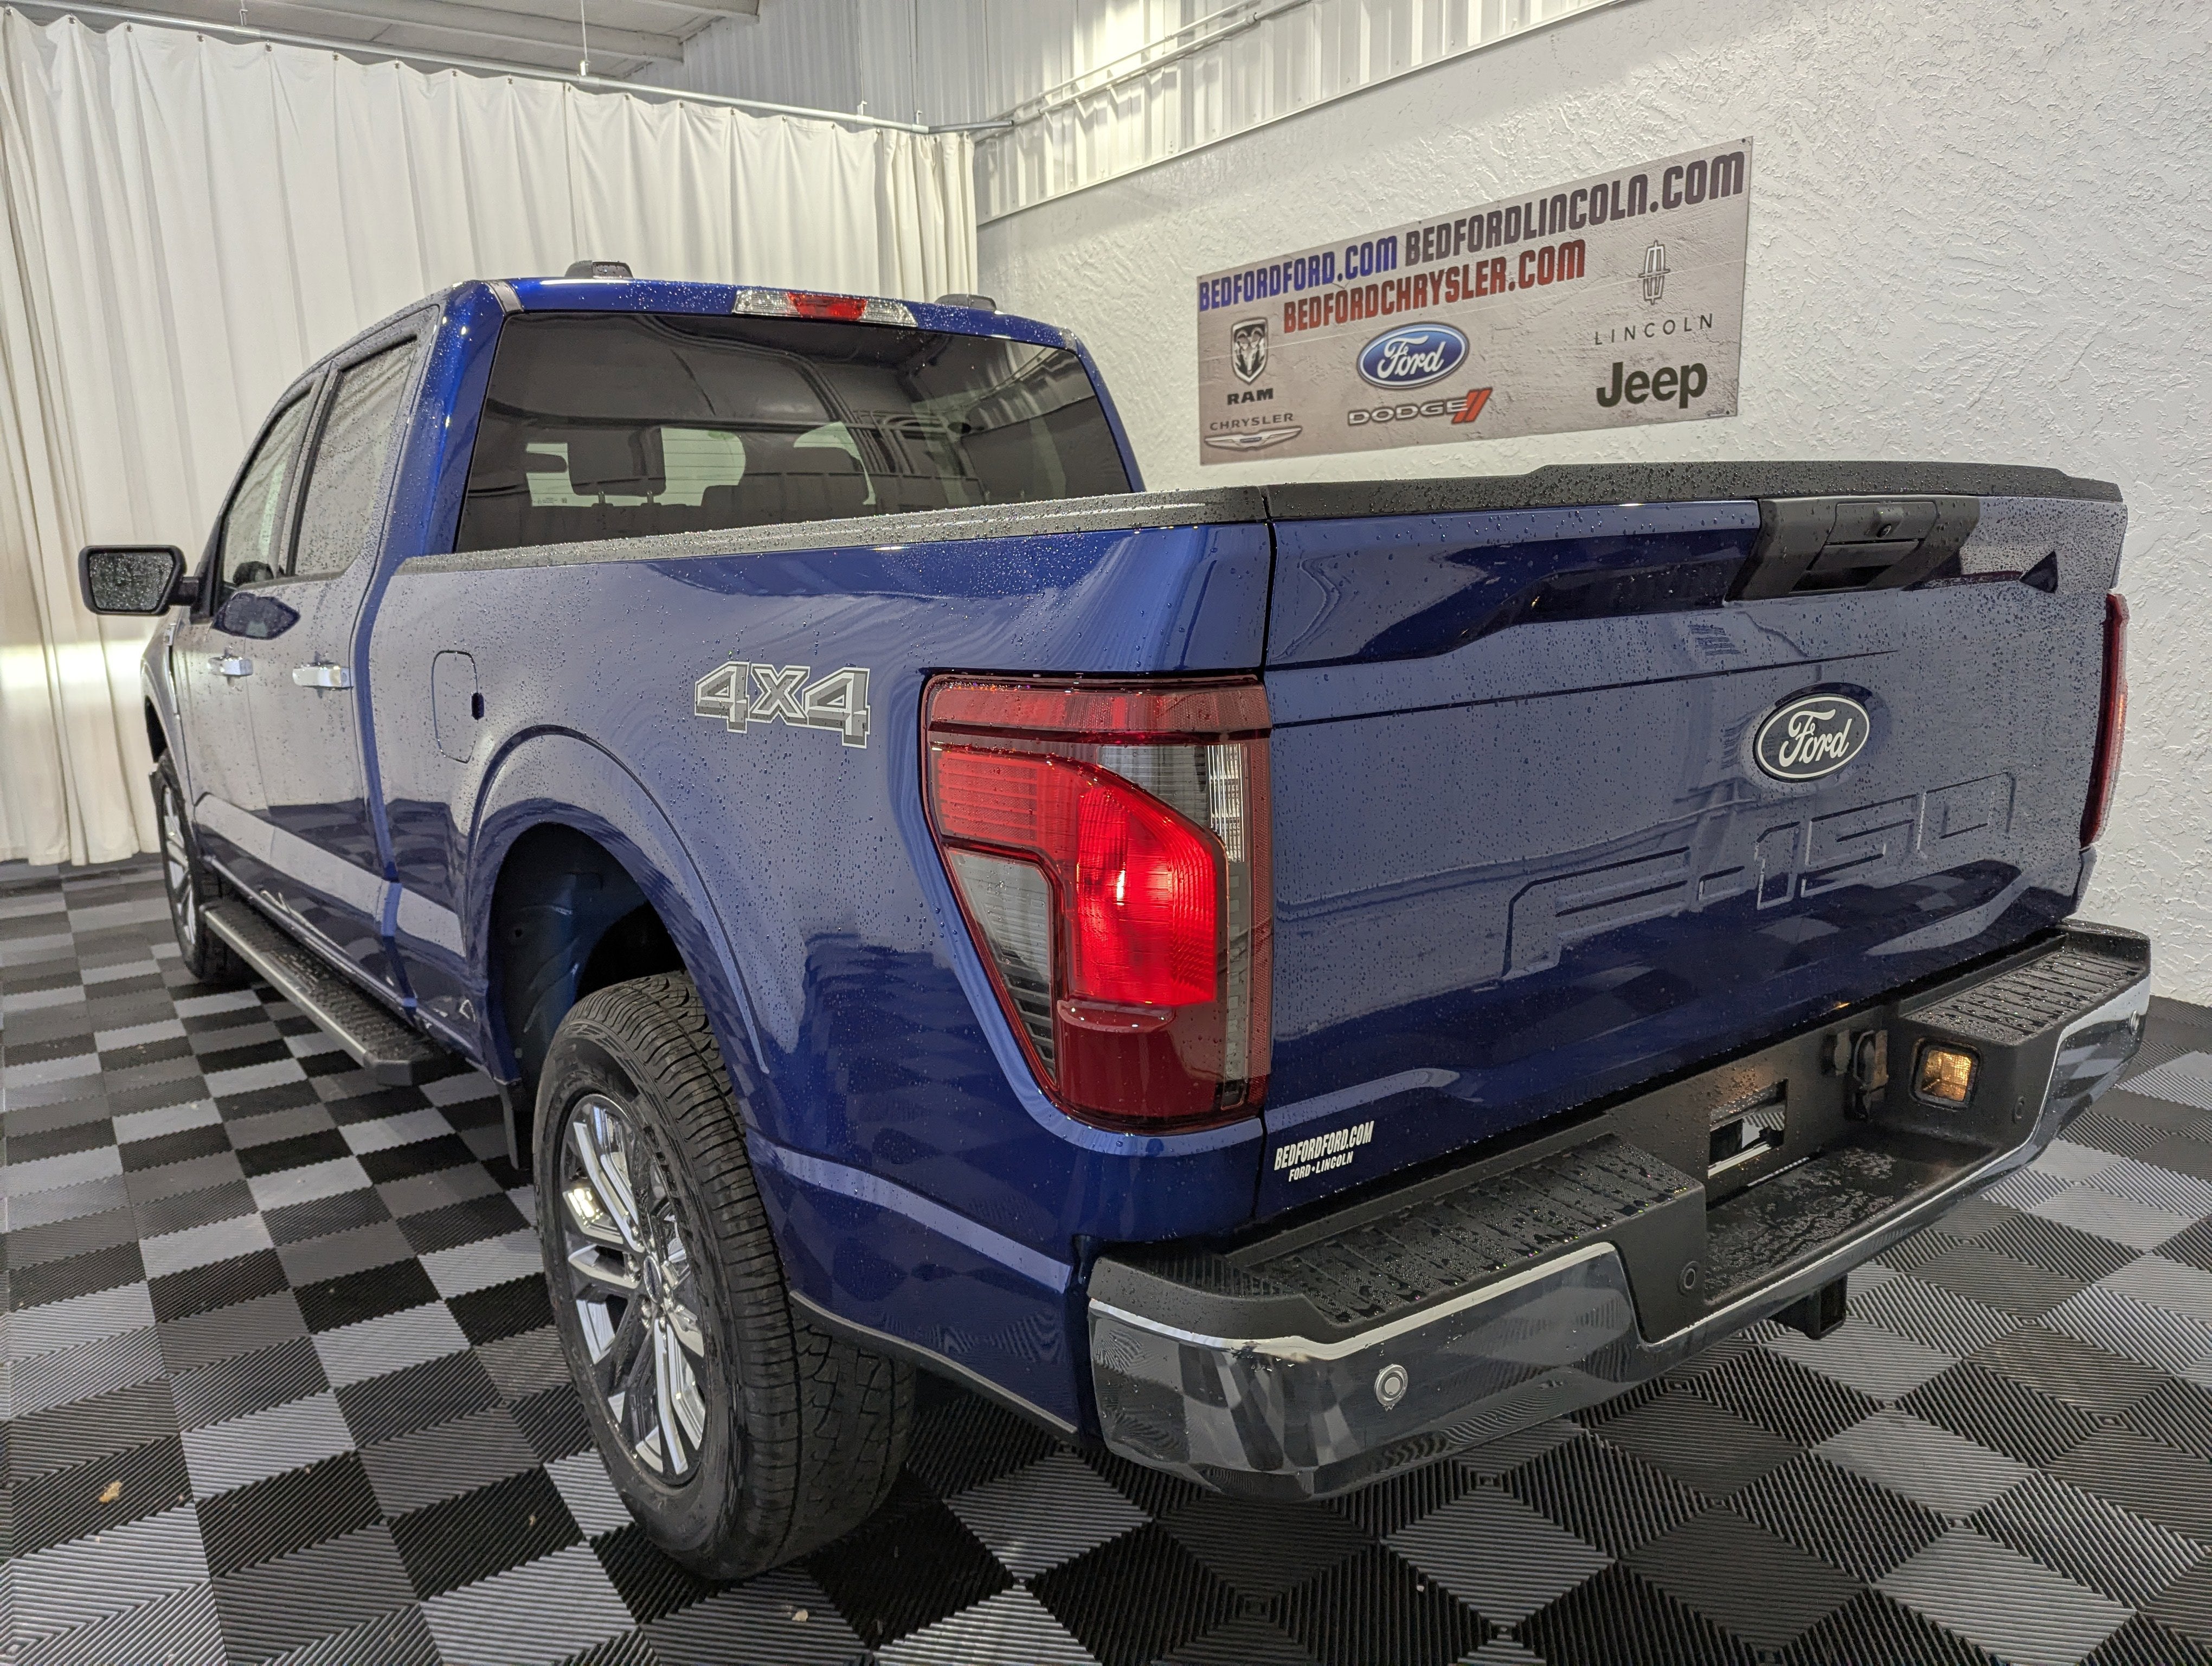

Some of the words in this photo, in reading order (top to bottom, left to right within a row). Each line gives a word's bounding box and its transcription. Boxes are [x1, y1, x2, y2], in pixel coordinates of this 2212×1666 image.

[1199, 235, 1398, 312] BEDFORDFORD.COM
[1405, 151, 1745, 267] BEDFORDLINCOLN.COM
[1284, 239, 1586, 334] BEDFORDCHRYSLER.COM
[1595, 313, 1713, 345] LINCOLN
[1377, 335, 1446, 379] Ford
[1227, 387, 1274, 406] RAM
[1596, 361, 1708, 409] Jeep
[1210, 413, 1294, 431] CHRYSLER
[1348, 398, 1468, 426] DODGE
[1779, 708, 1853, 767] Ford
[1274, 1120, 1375, 1171] BEDFORDFORD.COM
